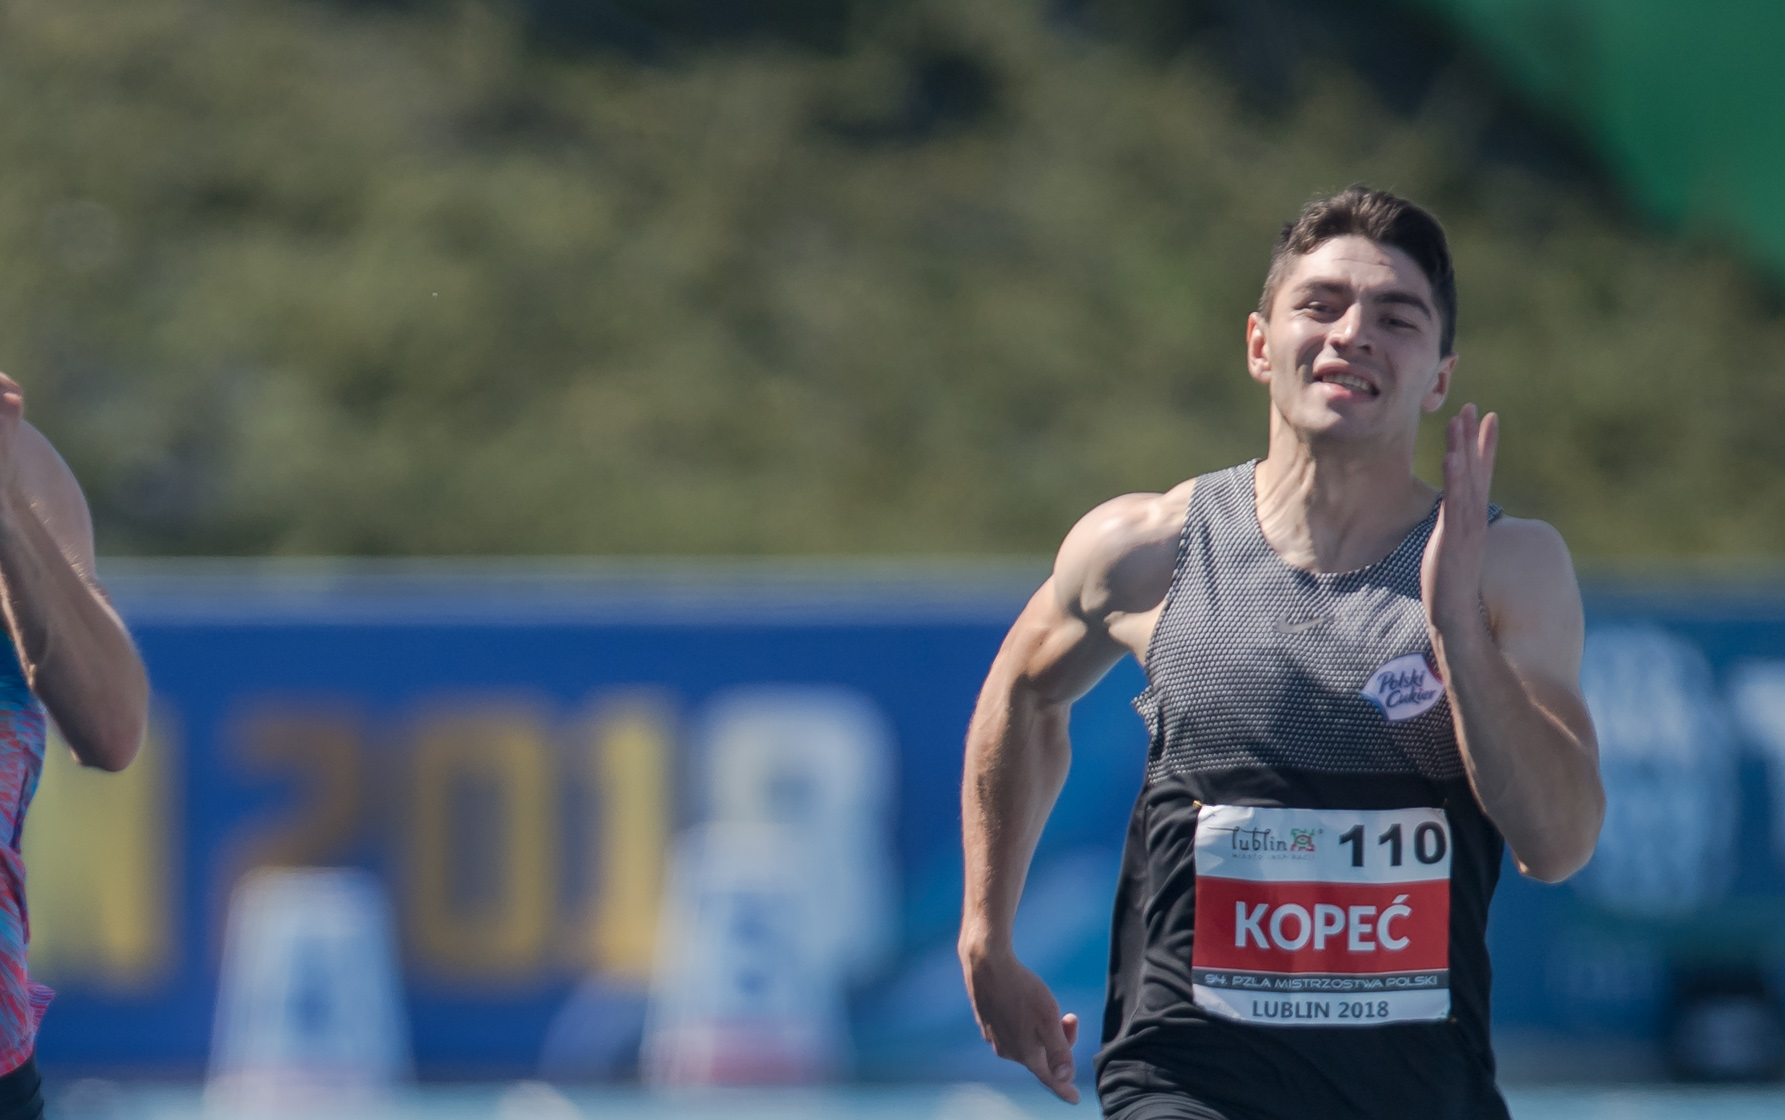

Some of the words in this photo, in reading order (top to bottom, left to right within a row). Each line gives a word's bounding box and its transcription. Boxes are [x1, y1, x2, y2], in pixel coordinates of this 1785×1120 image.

[1376, 668, 1428, 694] Polski
[1385, 685, 1438, 709] Cukier
[1338, 820, 1448, 868] 110
[1234, 893, 1414, 953] KOPEĆ
[1231, 975, 1271, 989] PZLA
[1273, 977, 1384, 990] MISTRZOSTWA
[1386, 974, 1439, 988] POLSKI
[1251, 1000, 1331, 1019] LUBLIN
[1337, 1000, 1390, 1019] 2018
